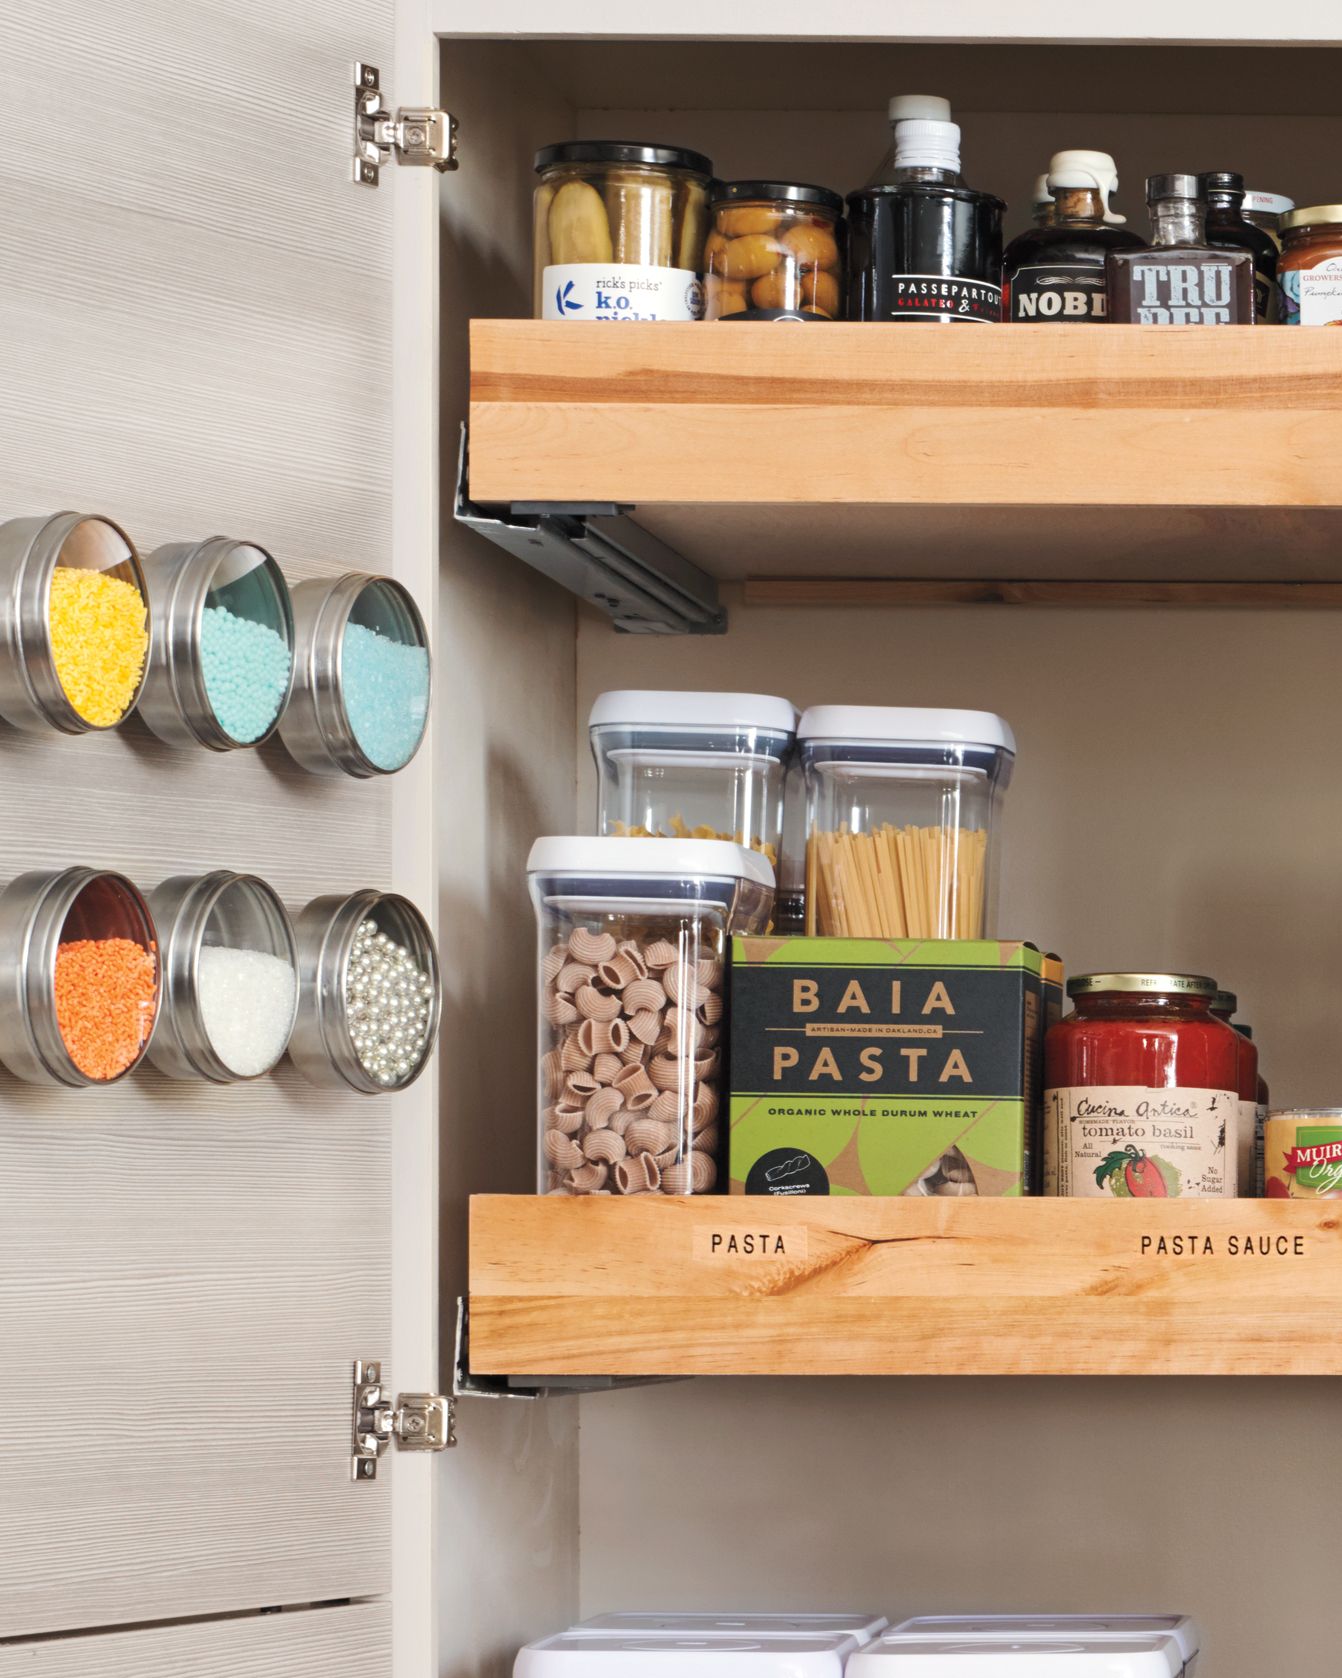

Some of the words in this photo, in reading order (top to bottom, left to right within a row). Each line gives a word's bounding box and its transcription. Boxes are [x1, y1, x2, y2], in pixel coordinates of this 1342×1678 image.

[595, 276, 626, 289] rick's
[1133, 264, 1232, 306] TRU
[958, 300, 970, 312] &
[793, 979, 956, 1015] BAIA
[773, 1046, 973, 1083] PASTA
[768, 1107, 827, 1116] ORGANIC
[831, 1108, 876, 1117] WHOLE
[881, 1110, 927, 1118] DURUM
[932, 1111, 978, 1119] WHEAT
[1077, 1099, 1129, 1118] Cucina
[1135, 1100, 1198, 1120] Antica
[1082, 1124, 1146, 1138] tomato
[1152, 1124, 1194, 1139] basil
[1082, 1142, 1094, 1150] All
[1296, 1143, 1342, 1163] MUIR
[1208, 1166, 1218, 1174] No
[1201, 1175, 1222, 1185] Sugar
[1201, 1184, 1223, 1194] Added
[711, 1233, 786, 1255] PASTA
[1141, 1235, 1214, 1256] PASTA
[1228, 1235, 1304, 1256] SAUCE
